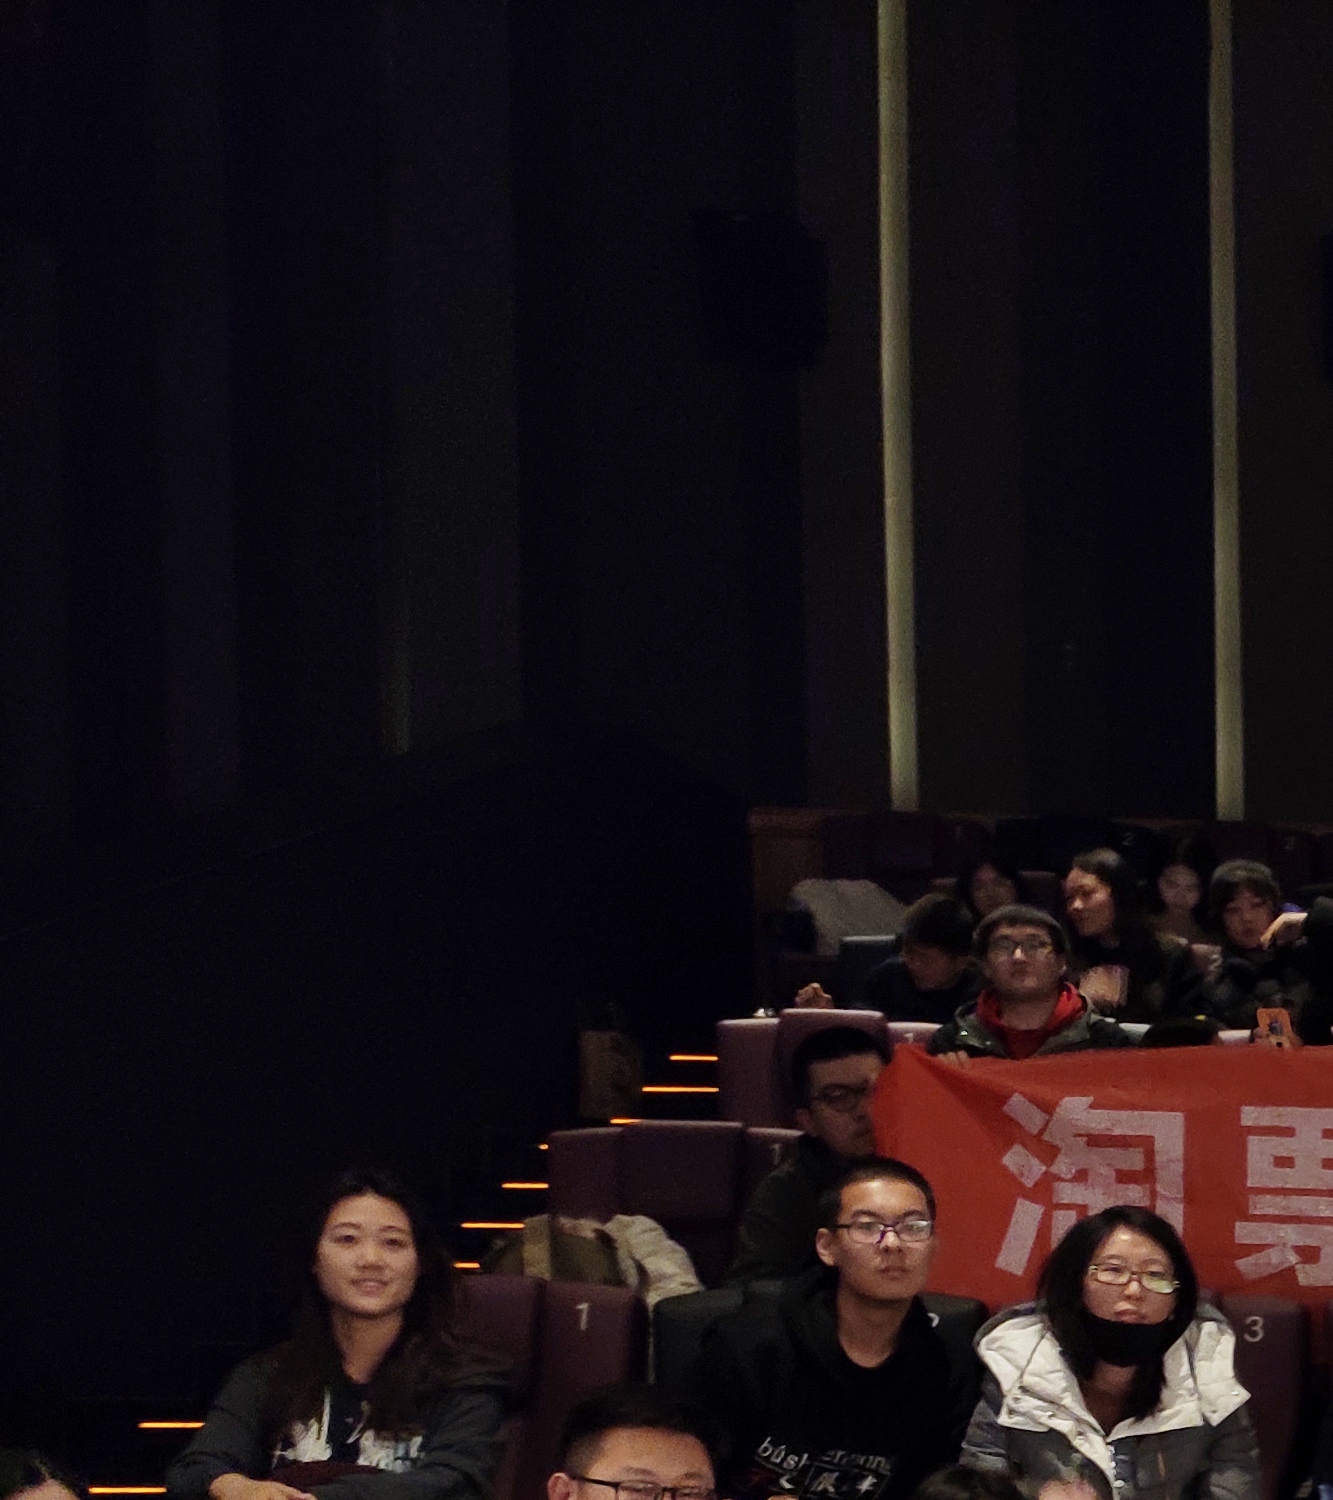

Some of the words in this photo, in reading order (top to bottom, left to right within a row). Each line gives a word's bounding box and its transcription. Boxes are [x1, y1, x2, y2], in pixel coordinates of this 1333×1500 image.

[1209, 955, 1223, 971] 2
[575, 1302, 588, 1332] 1
[1244, 1316, 1265, 1343] 3
